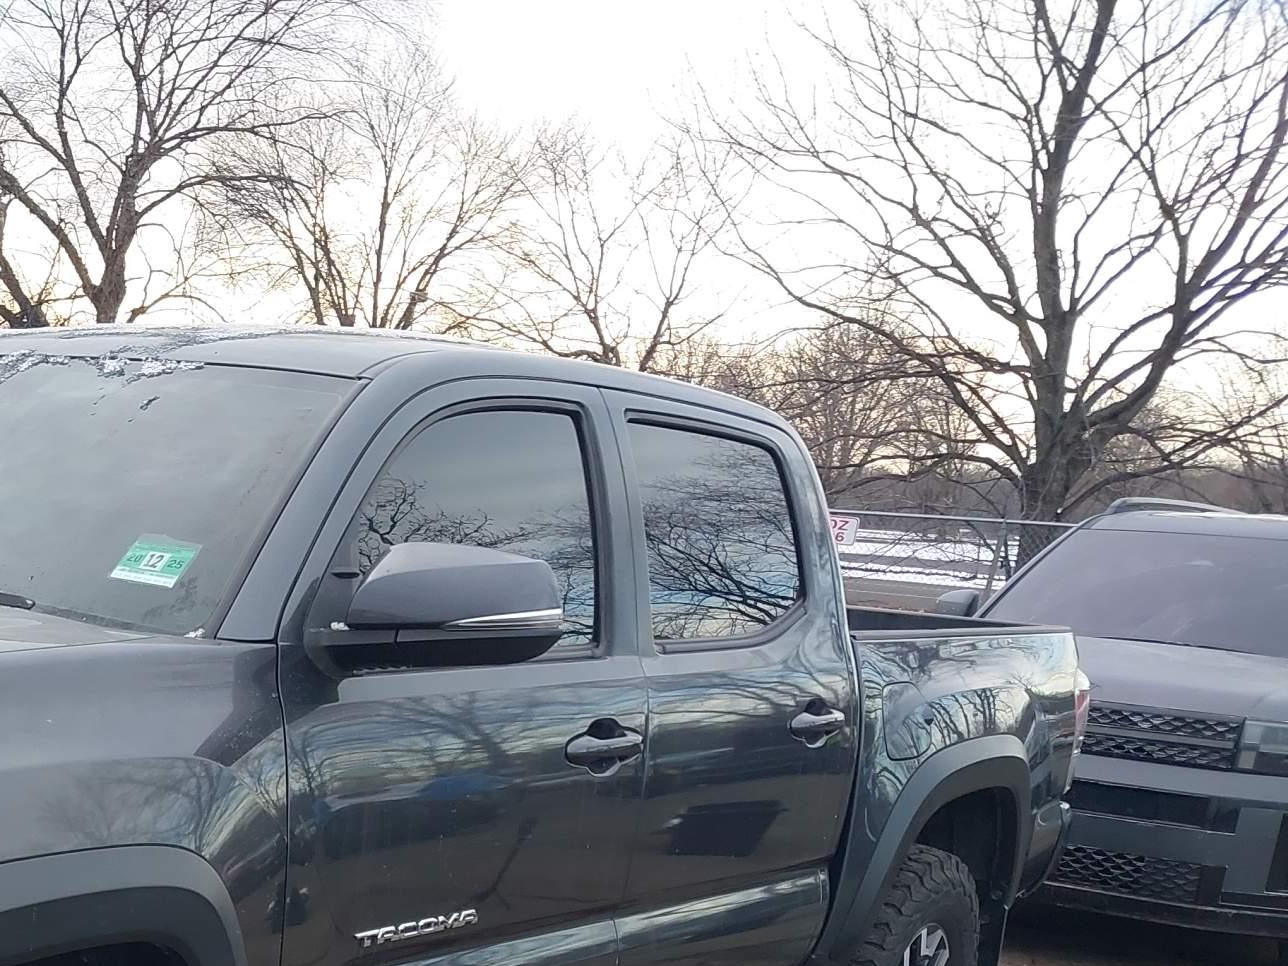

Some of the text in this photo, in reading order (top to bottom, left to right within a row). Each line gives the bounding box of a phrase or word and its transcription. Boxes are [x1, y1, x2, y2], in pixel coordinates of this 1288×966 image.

[127, 553, 185, 570] 20 12 25
[354, 908, 479, 947] TACOMA
